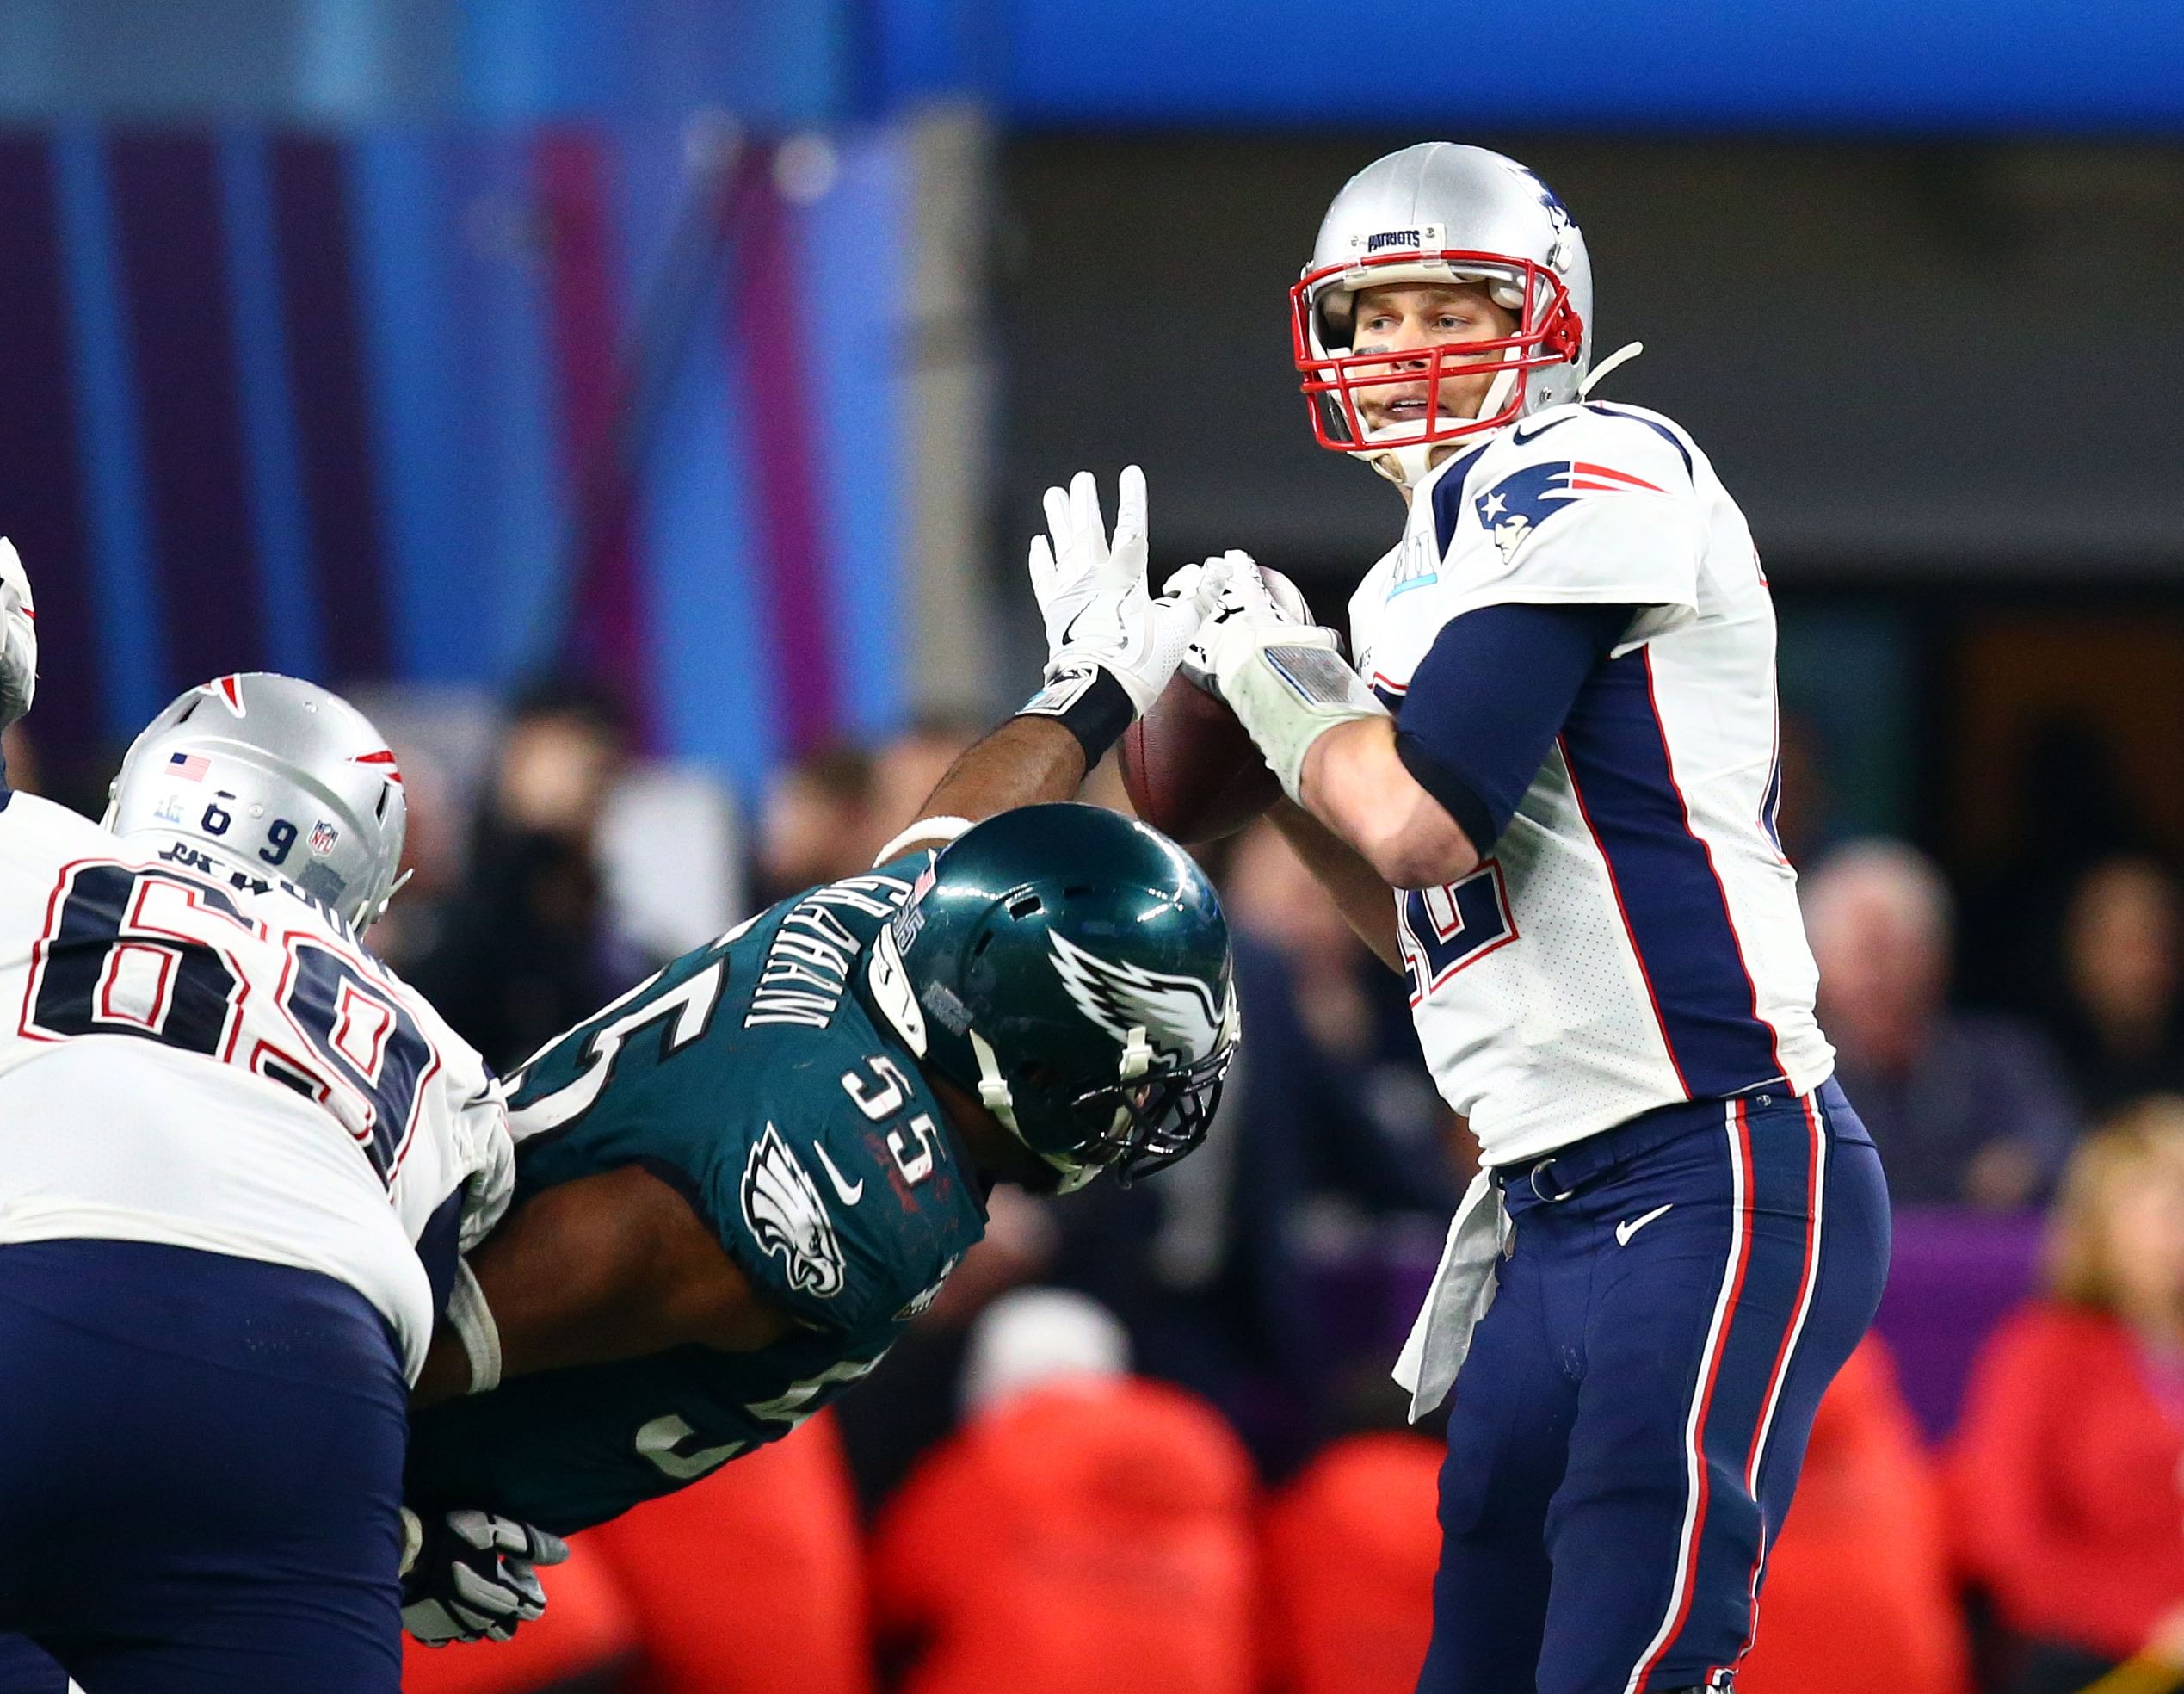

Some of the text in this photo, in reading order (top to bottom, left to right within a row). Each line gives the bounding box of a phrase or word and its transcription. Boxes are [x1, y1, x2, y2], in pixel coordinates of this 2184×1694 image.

[1367, 229, 1421, 253] PATRIOTS
[311, 831, 335, 853] NFL
[743, 874, 914, 1029] GRAHAM
[17, 857, 441, 1202] 69
[840, 1054, 947, 1187] 55
